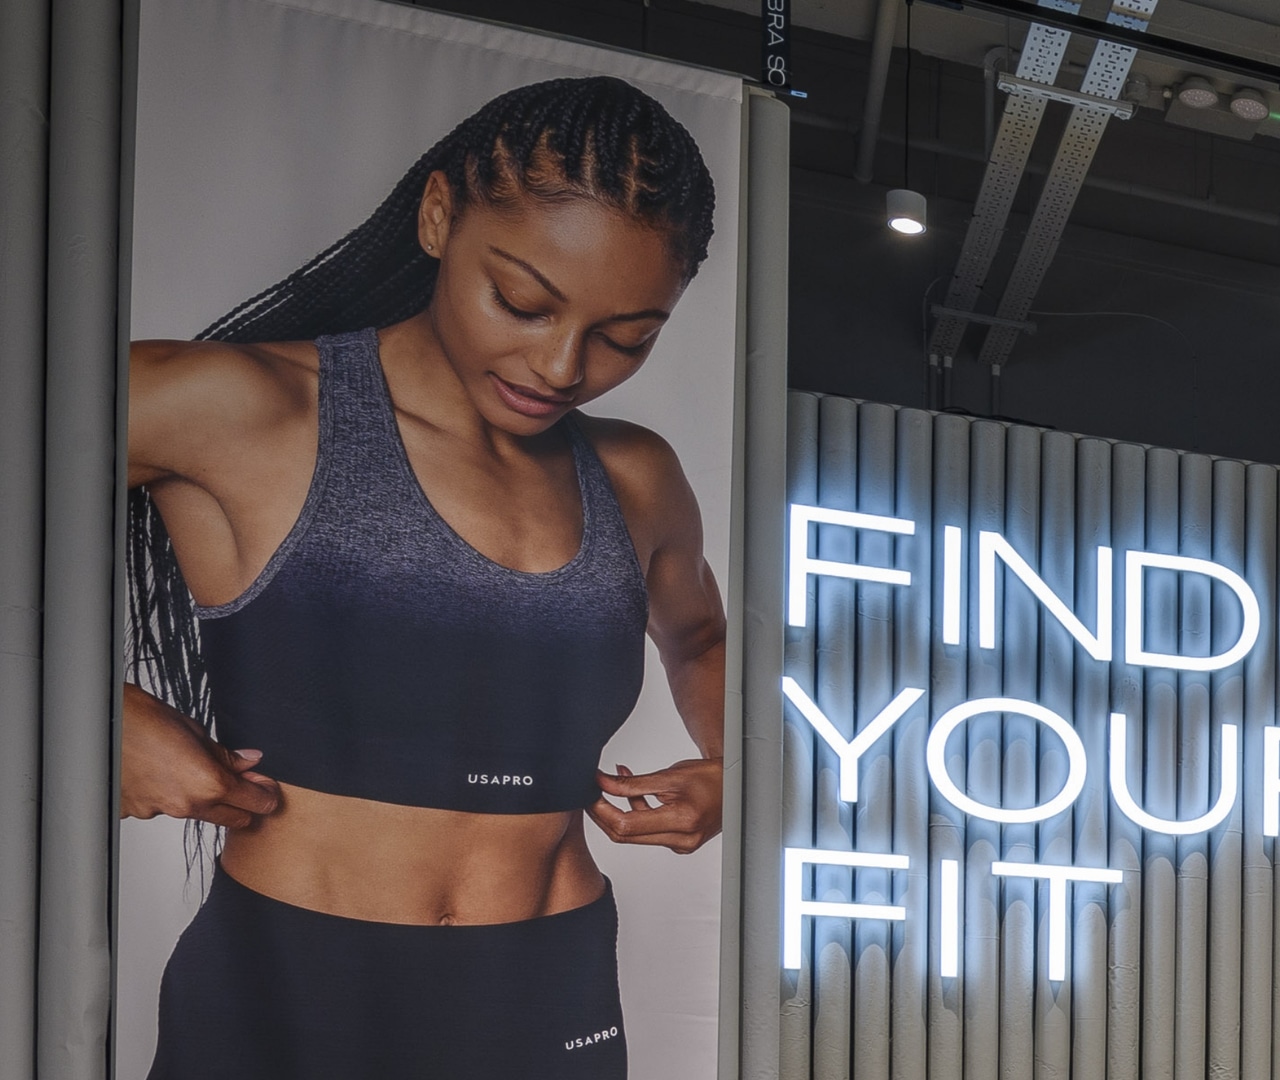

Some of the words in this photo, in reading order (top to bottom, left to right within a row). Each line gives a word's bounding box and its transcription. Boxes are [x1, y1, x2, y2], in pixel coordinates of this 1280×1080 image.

[788, 504, 1260, 671] FIND
[467, 773, 534, 786] USAPRO
[784, 848, 1123, 982] FIT
[565, 1026, 619, 1050] USAPRO
